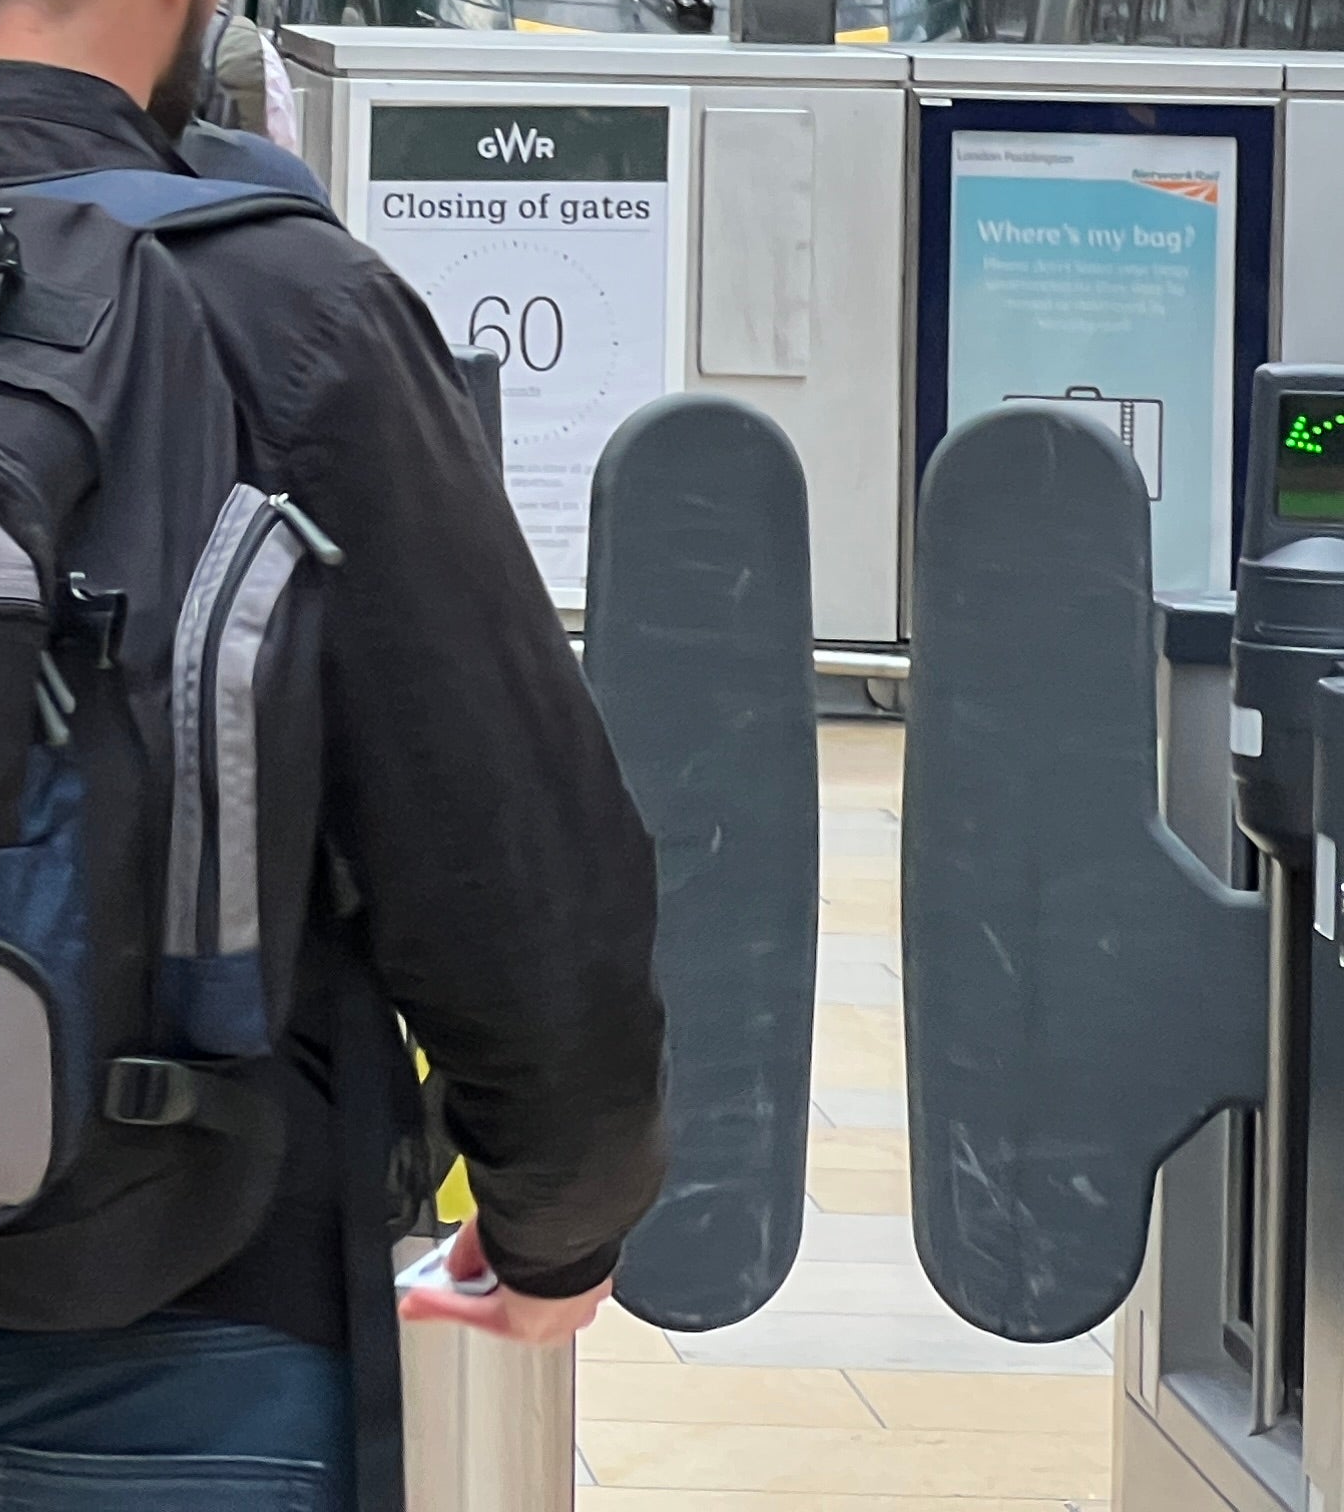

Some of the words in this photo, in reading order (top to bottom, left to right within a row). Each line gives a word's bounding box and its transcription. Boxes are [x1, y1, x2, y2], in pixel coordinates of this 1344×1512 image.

[476, 121, 555, 164] GWR
[383, 192, 507, 224] Closing
[518, 193, 552, 219] of
[559, 196, 651, 224] gates
[977, 219, 1082, 246] Where's
[1087, 226, 1126, 252] my
[1133, 225, 1197, 254] bag?
[468, 295, 564, 372] 60
